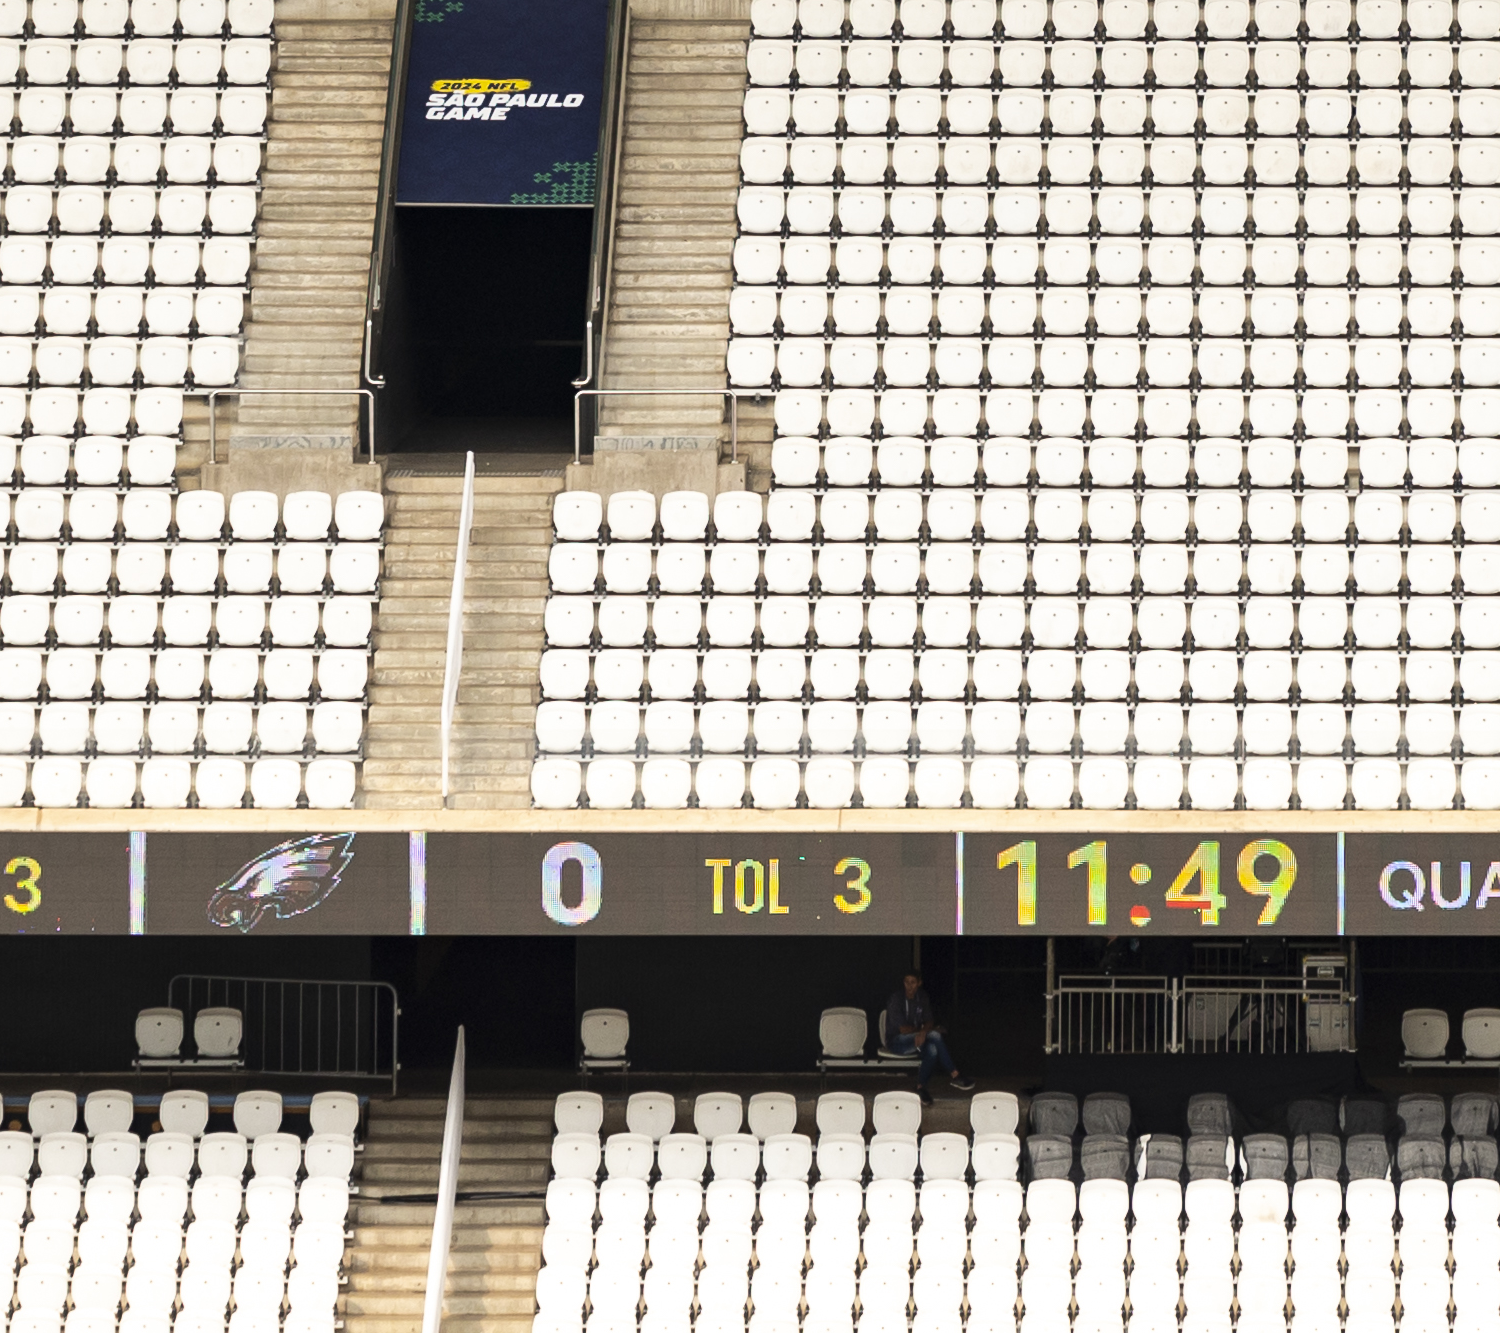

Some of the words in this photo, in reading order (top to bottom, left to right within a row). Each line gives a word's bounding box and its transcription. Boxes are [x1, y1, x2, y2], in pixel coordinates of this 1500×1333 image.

[425, 107, 512, 121] GAME
[426, 90, 486, 108] SÃO
[488, 93, 585, 108] PAULO
[440, 82, 482, 91] 2024
[487, 82, 520, 91] NFL
[3, 856, 43, 915] 3
[541, 840, 604, 927] 0
[705, 857, 790, 916] TOL
[833, 856, 873, 916] 3
[995, 838, 1299, 927] 11:49
